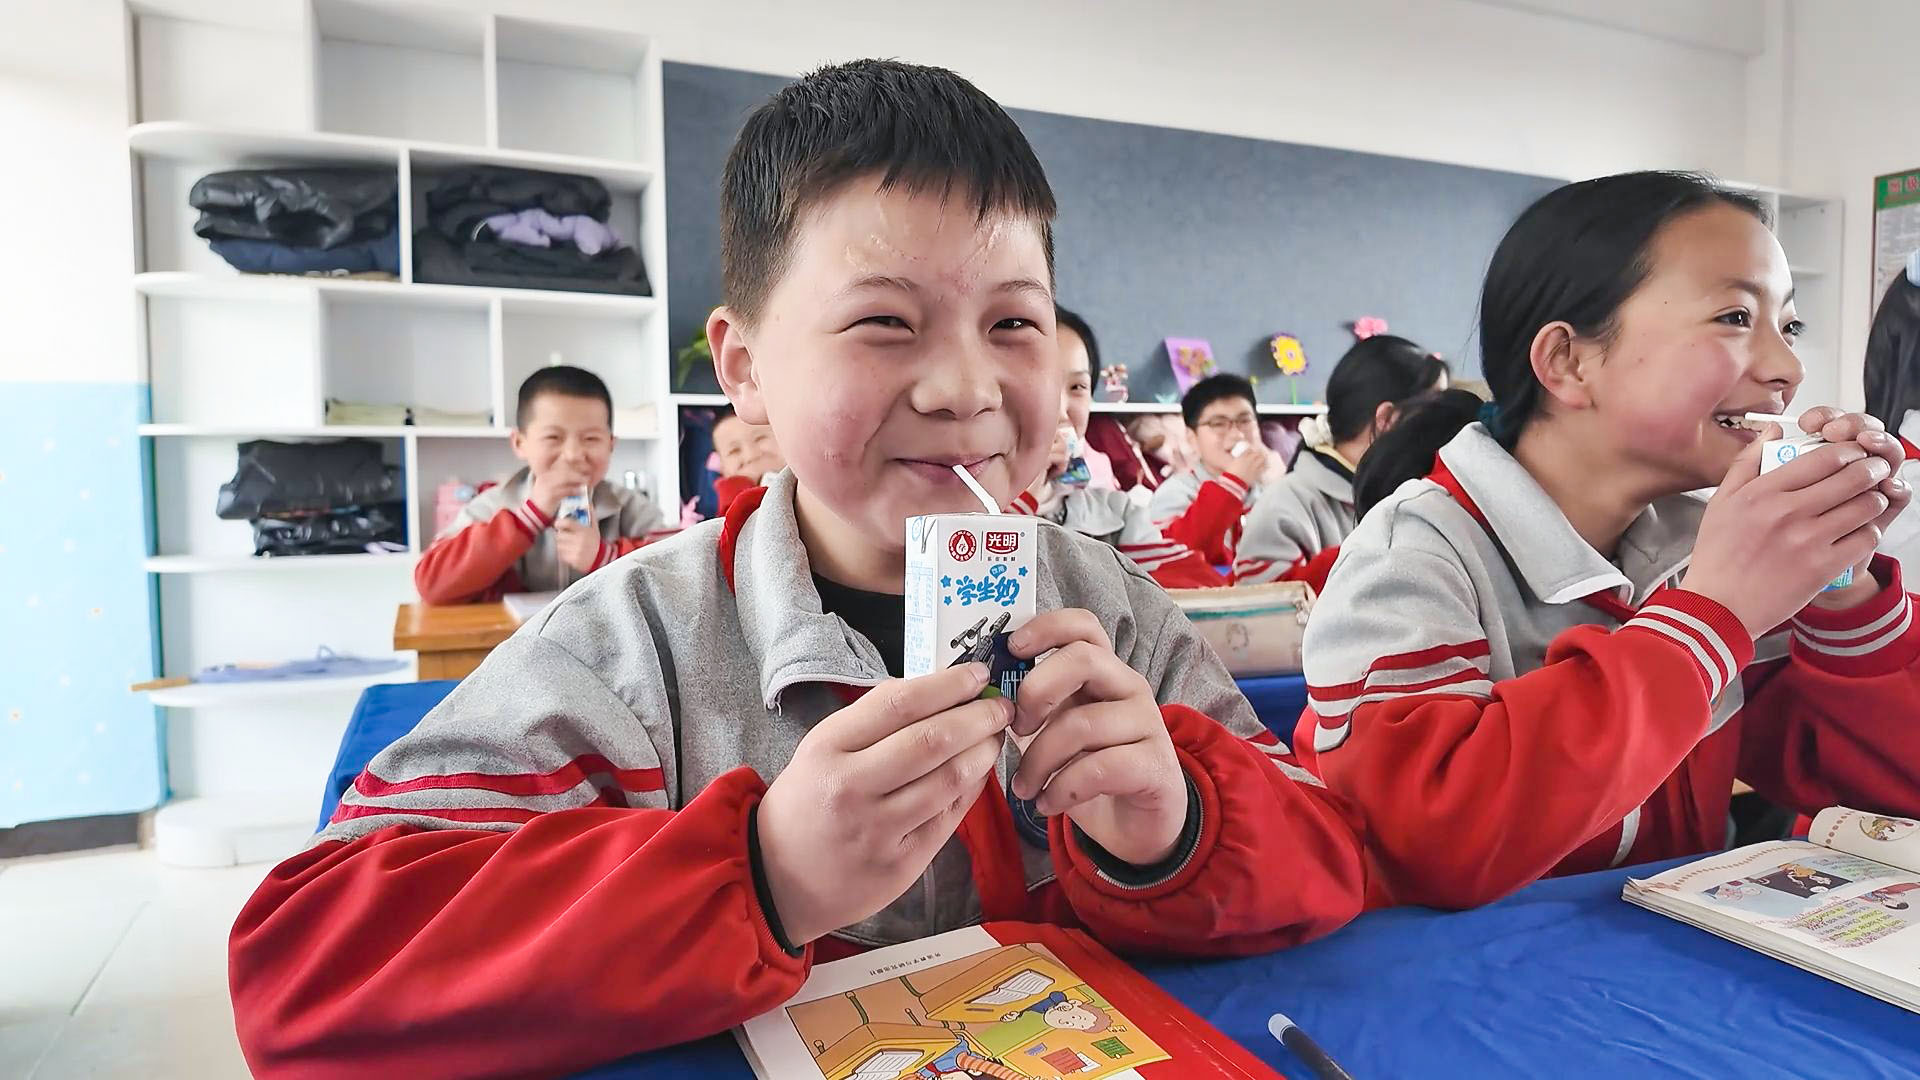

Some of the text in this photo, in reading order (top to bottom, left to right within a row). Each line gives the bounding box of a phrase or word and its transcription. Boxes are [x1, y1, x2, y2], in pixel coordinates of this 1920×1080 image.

[988, 534, 1016, 547] 光明
[956, 575, 1020, 607] 学生奶
